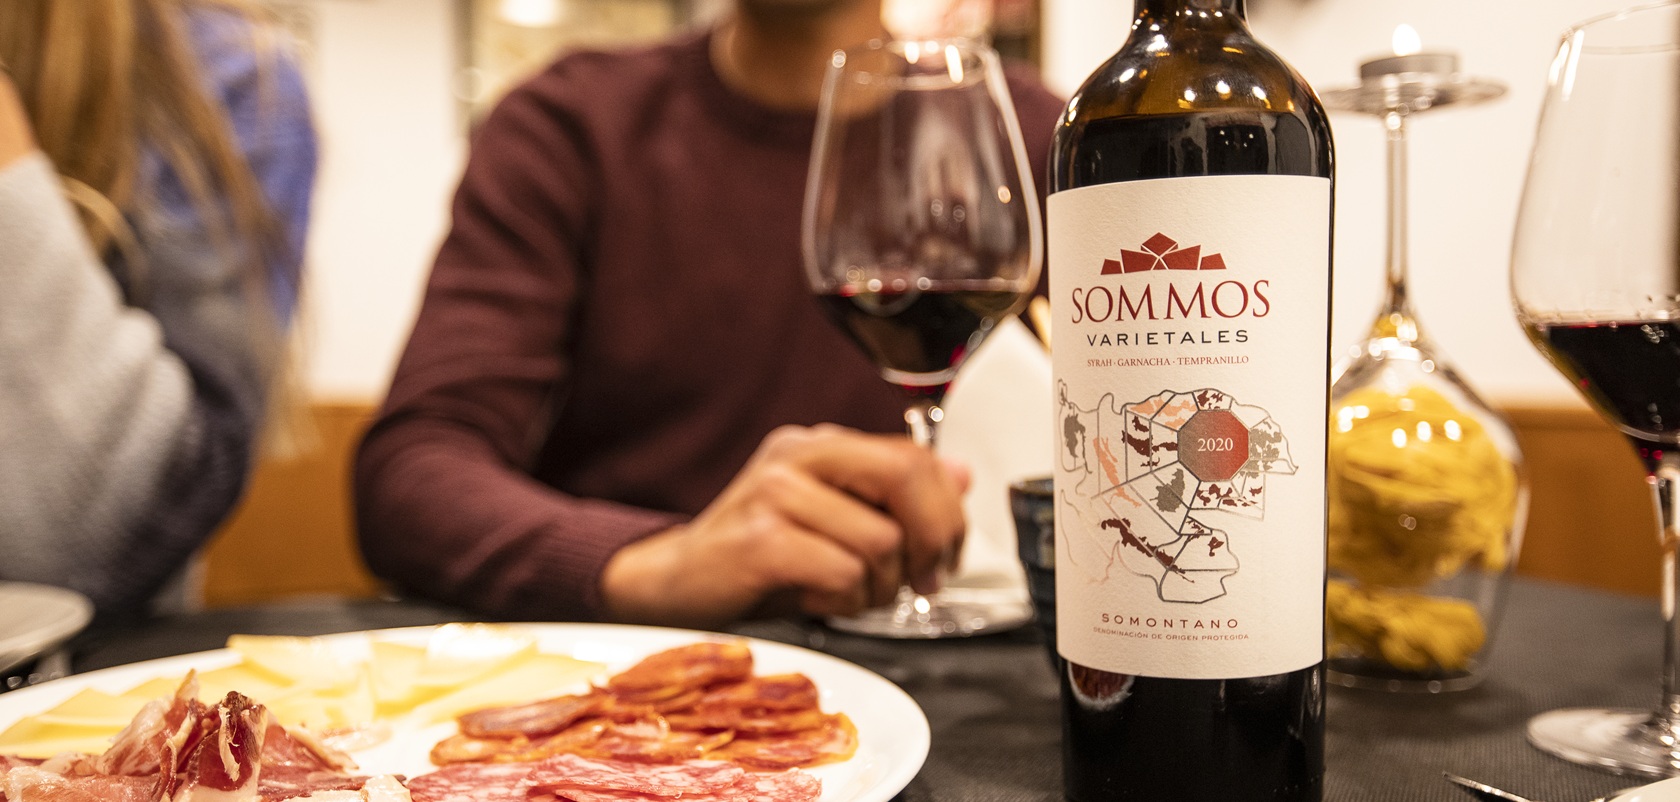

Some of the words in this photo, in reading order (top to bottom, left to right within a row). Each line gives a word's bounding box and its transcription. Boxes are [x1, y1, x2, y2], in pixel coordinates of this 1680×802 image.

[1071, 279, 1270, 324] SOMMOS
[1087, 329, 1249, 347] VARIETALES
[1087, 358, 1113, 368] SYRAH
[1117, 357, 1171, 367] GARNACHA
[1177, 355, 1249, 366] TEMPRANILLO
[1197, 437, 1234, 452] 2020
[1101, 612, 1239, 629] SOMONTANO
[1201, 633, 1249, 641] PROTEGIDA
